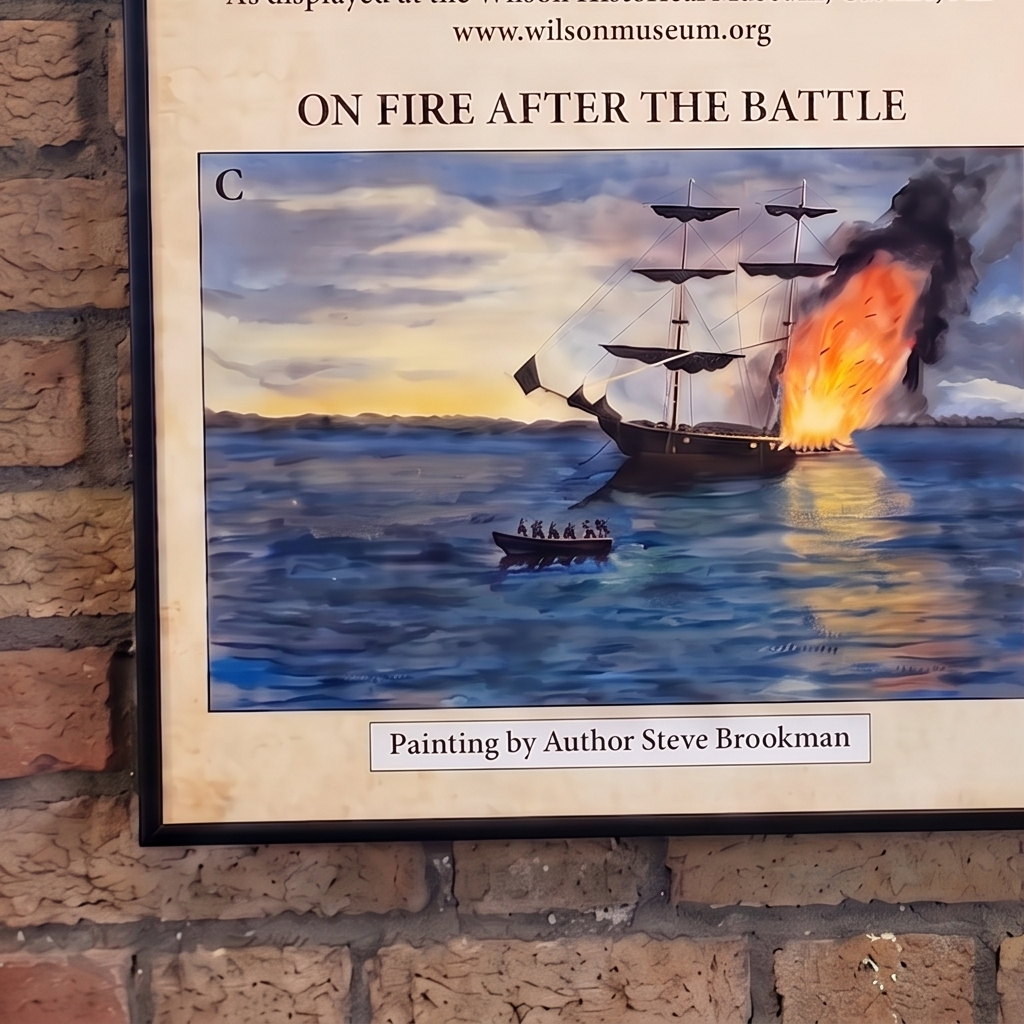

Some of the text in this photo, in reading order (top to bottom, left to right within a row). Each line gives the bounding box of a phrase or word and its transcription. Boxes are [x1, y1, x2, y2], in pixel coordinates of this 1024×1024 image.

[452, 17, 772, 48] www.wilsonmuseum.org
[297, 89, 907, 127] ON FIRE AFTER THE BATTLE
[215, 168, 243, 201] C
[389, 725, 851, 761] Painting by Author Steve Brookman
